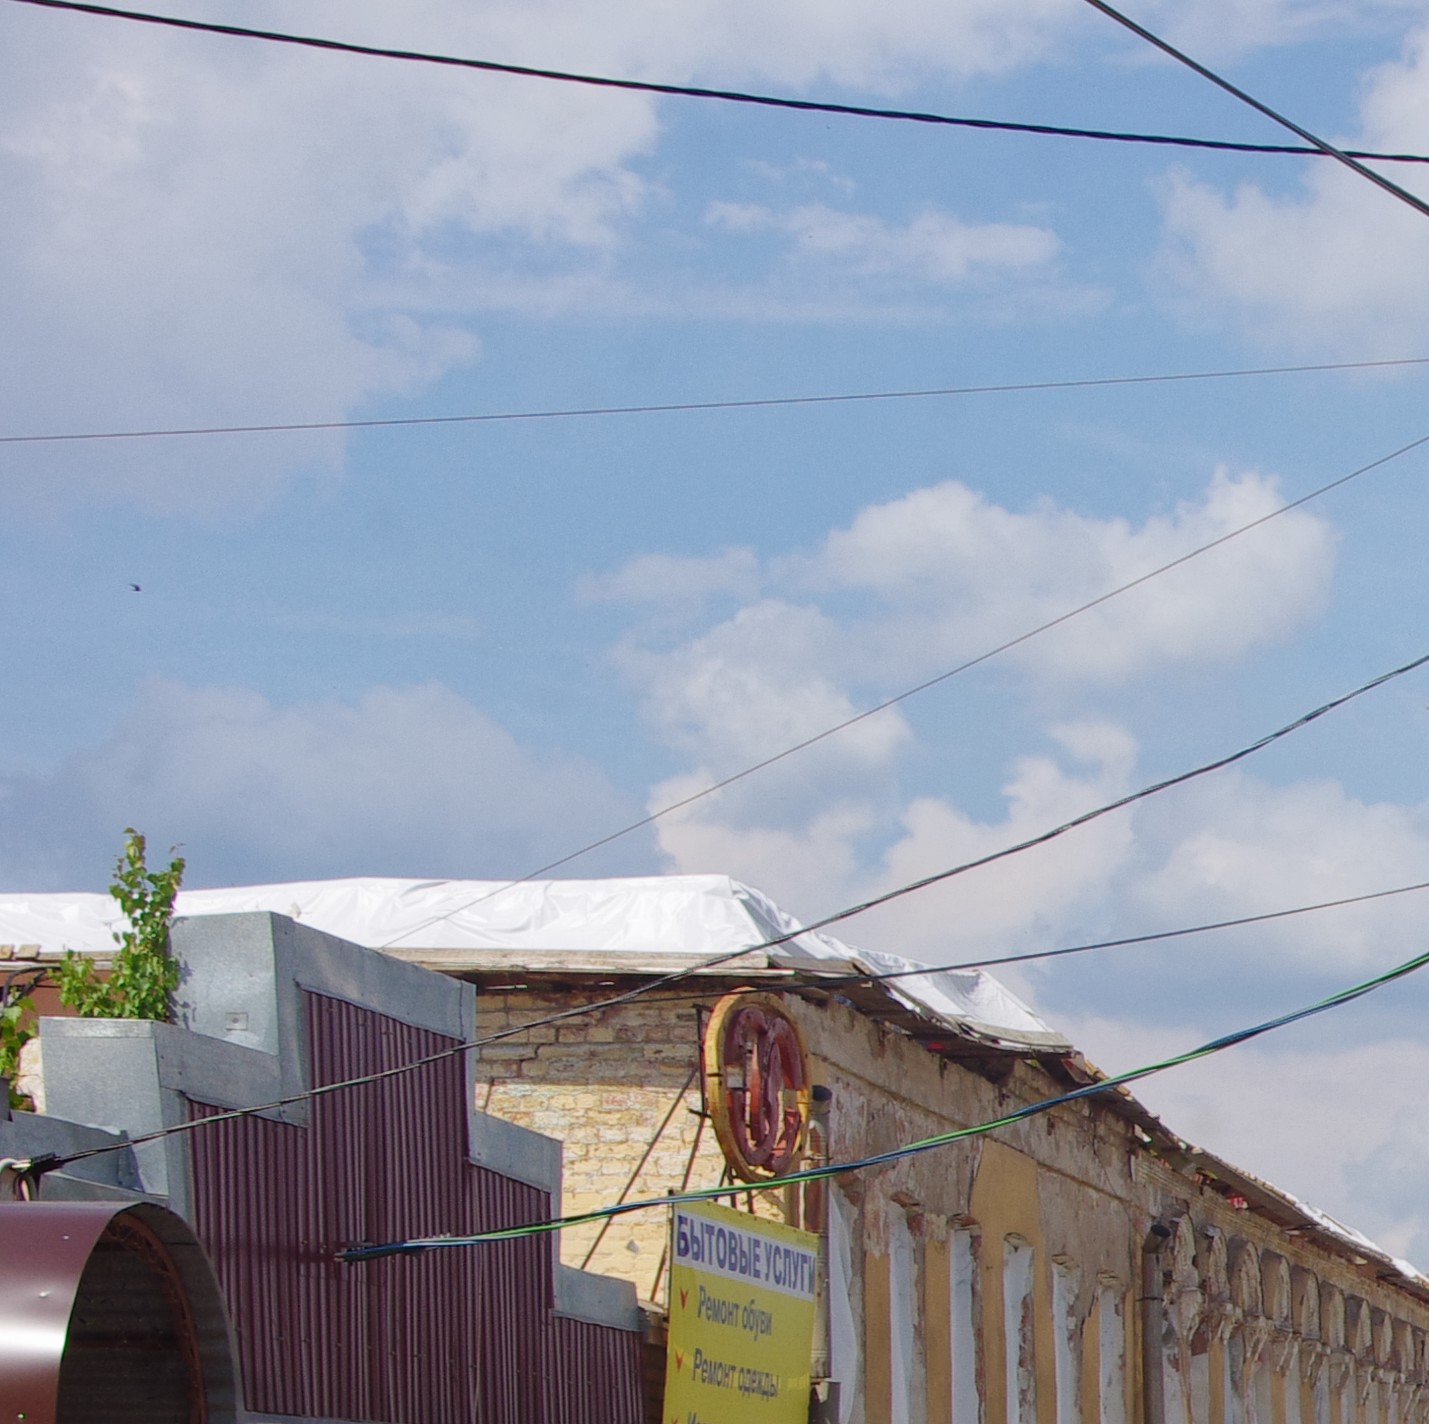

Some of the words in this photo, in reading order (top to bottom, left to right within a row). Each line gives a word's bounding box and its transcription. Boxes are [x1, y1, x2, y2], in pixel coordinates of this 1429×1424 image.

[677, 1215, 761, 1279] БЫТОВЫЕ
[764, 1241, 816, 1295] УСЛУГИ
[697, 1285, 739, 1328] Ремонт
[742, 1299, 772, 1341] обуви
[693, 1348, 736, 1389] Ремонт
[738, 1367, 780, 1402] одежды
